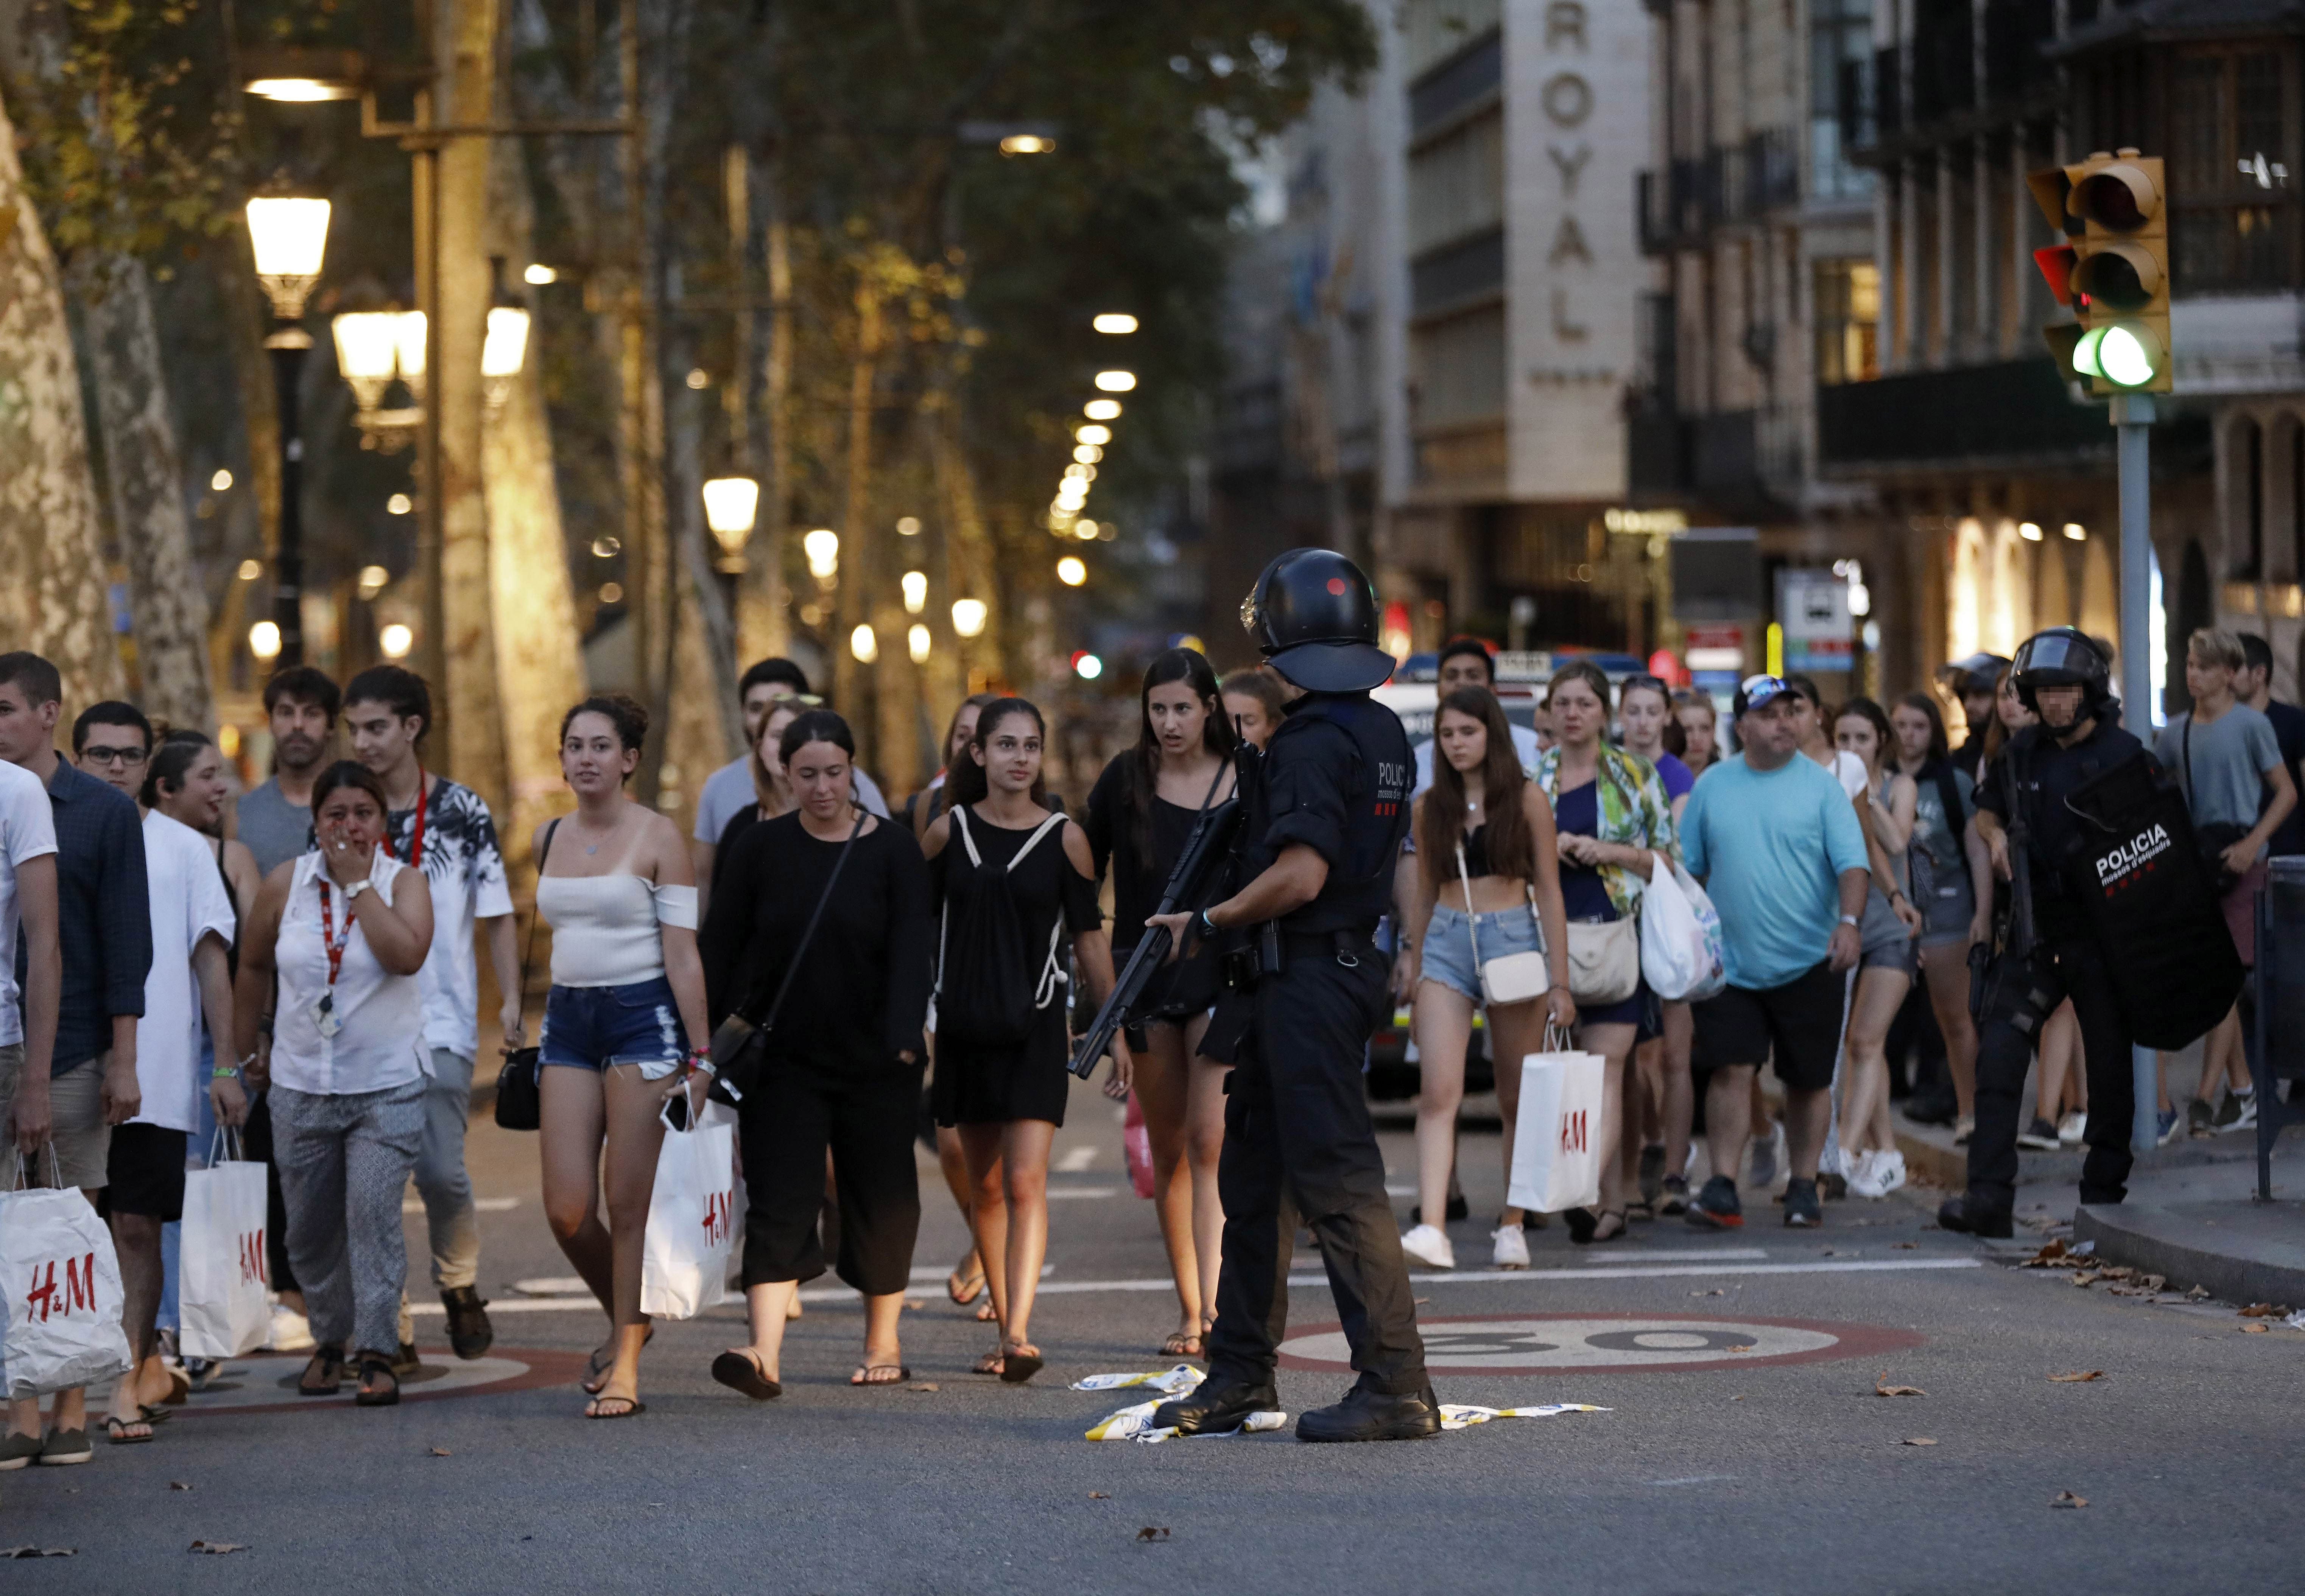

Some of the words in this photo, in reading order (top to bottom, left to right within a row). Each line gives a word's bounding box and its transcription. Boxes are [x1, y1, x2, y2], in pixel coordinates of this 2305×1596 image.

[1541, 2, 1595, 342] ROYAL
[2096, 823, 2168, 878] POLICIA
[2101, 863, 2131, 887] mossos
[27, 1252, 96, 1323] H&M
